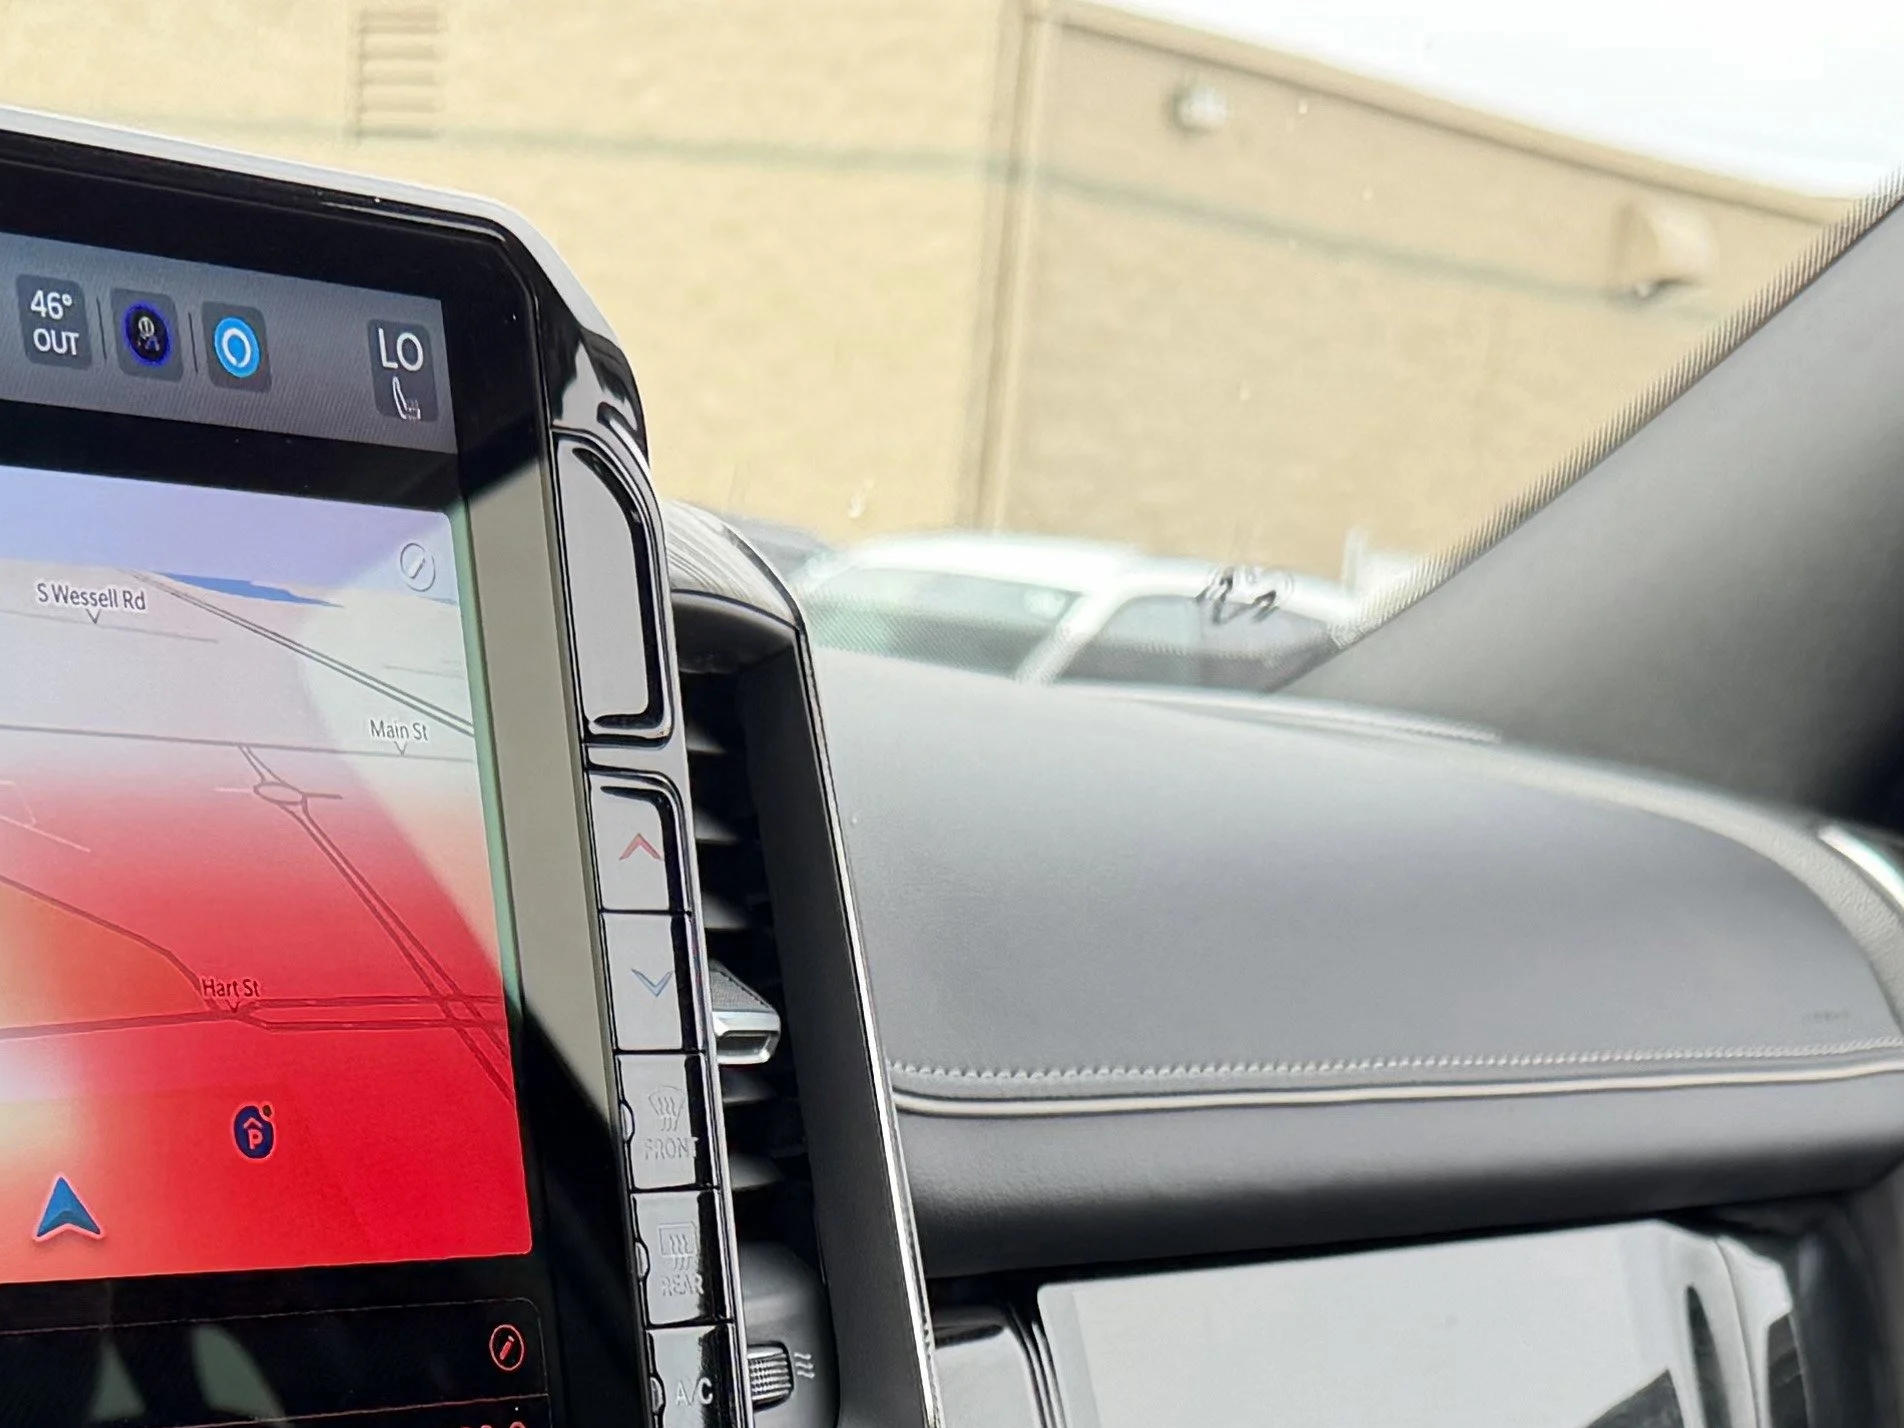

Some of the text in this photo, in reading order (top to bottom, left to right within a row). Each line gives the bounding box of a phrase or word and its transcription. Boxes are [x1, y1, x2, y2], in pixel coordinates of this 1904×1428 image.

[32, 327, 80, 356] OUT
[377, 327, 425, 373] LO
[36, 582, 146, 611] S Wessell Rd
[370, 719, 428, 742] Main St
[201, 978, 260, 998] Hart St
[675, 1376, 714, 1406] A/C
